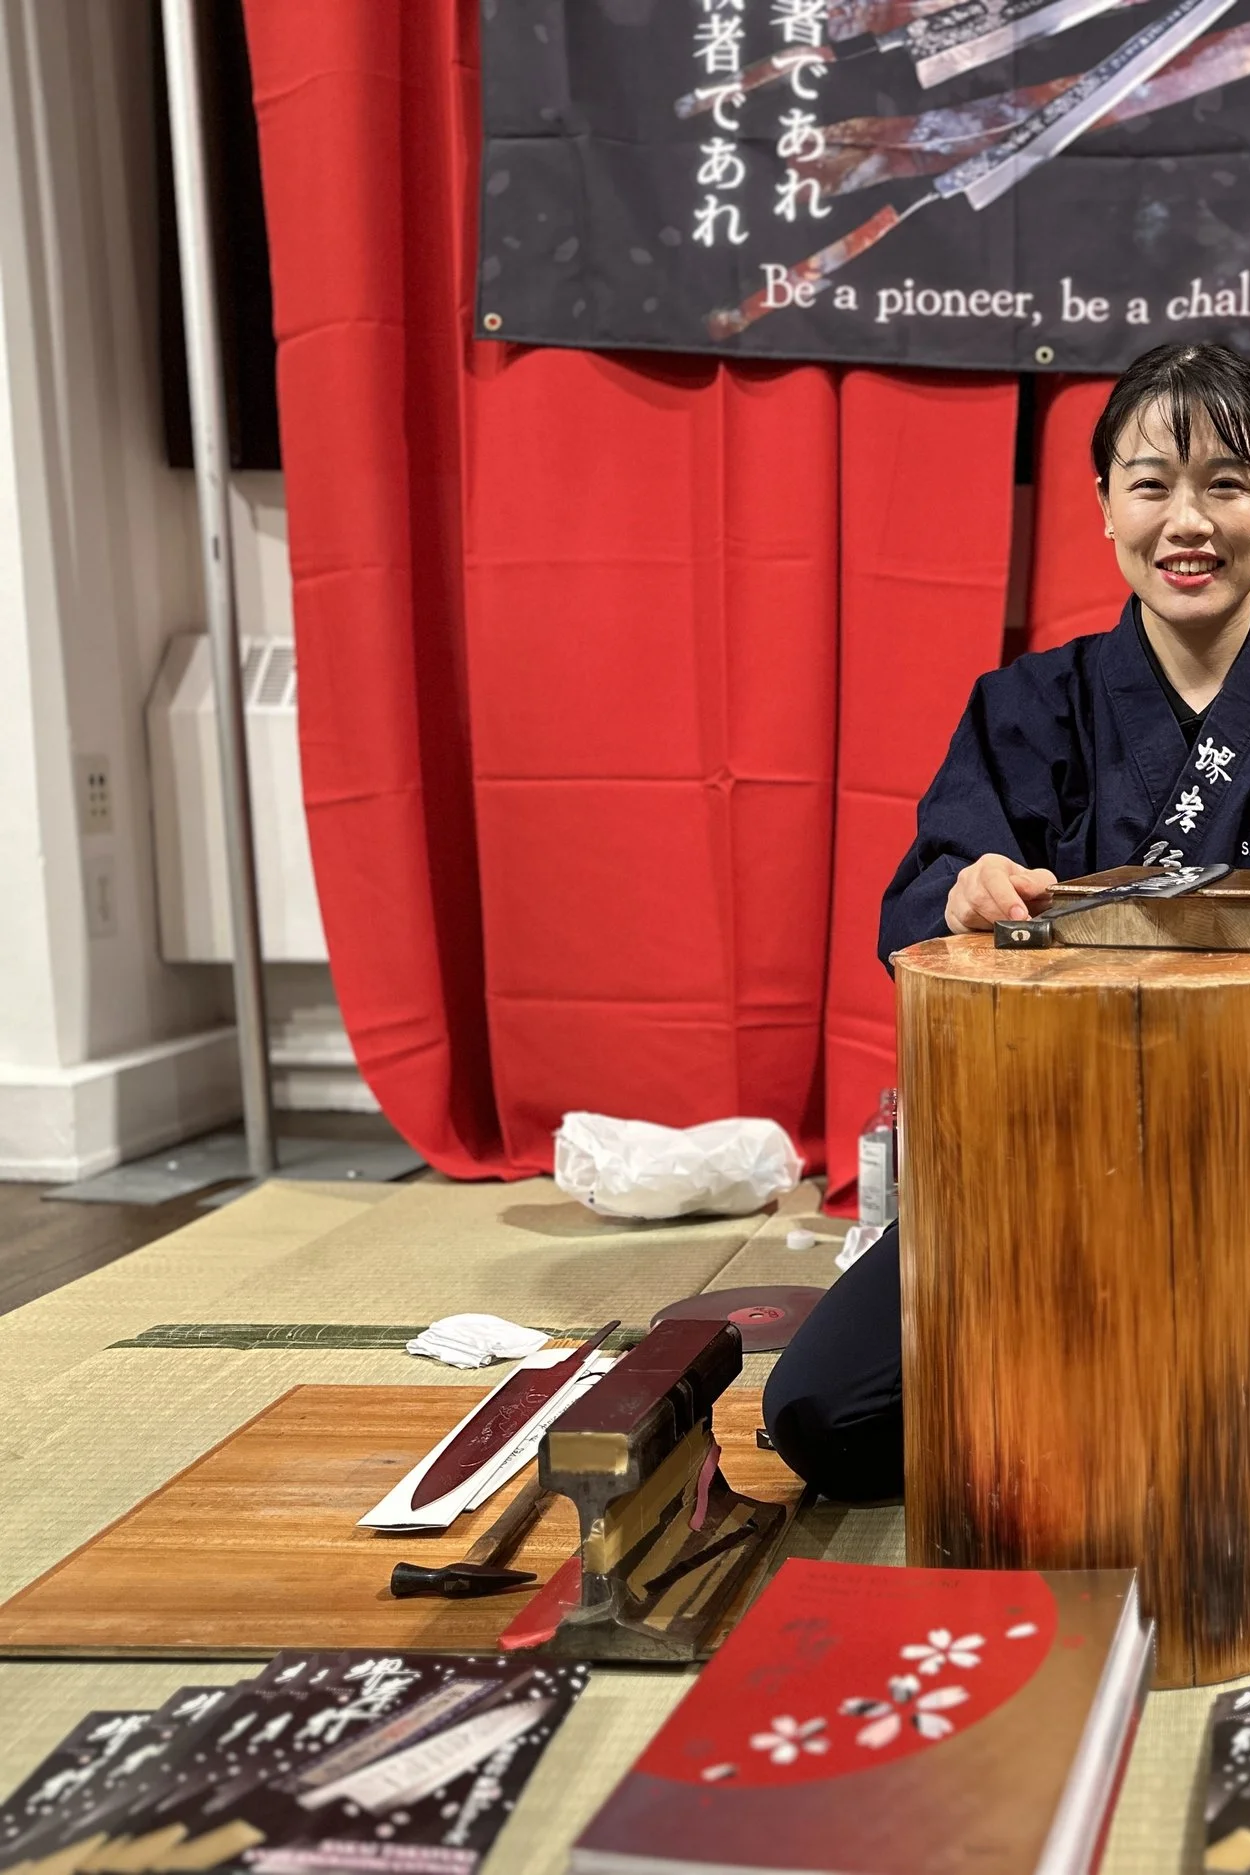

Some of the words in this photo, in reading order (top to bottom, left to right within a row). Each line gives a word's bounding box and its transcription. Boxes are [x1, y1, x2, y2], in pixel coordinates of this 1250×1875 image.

[691, 0, 749, 247] 者であれ
[760, 264, 817, 308] Be
[833, 284, 858, 310] a
[875, 278, 1043, 326] pioneer,
[1060, 277, 1110, 322] be
[1126, 297, 1150, 324] a
